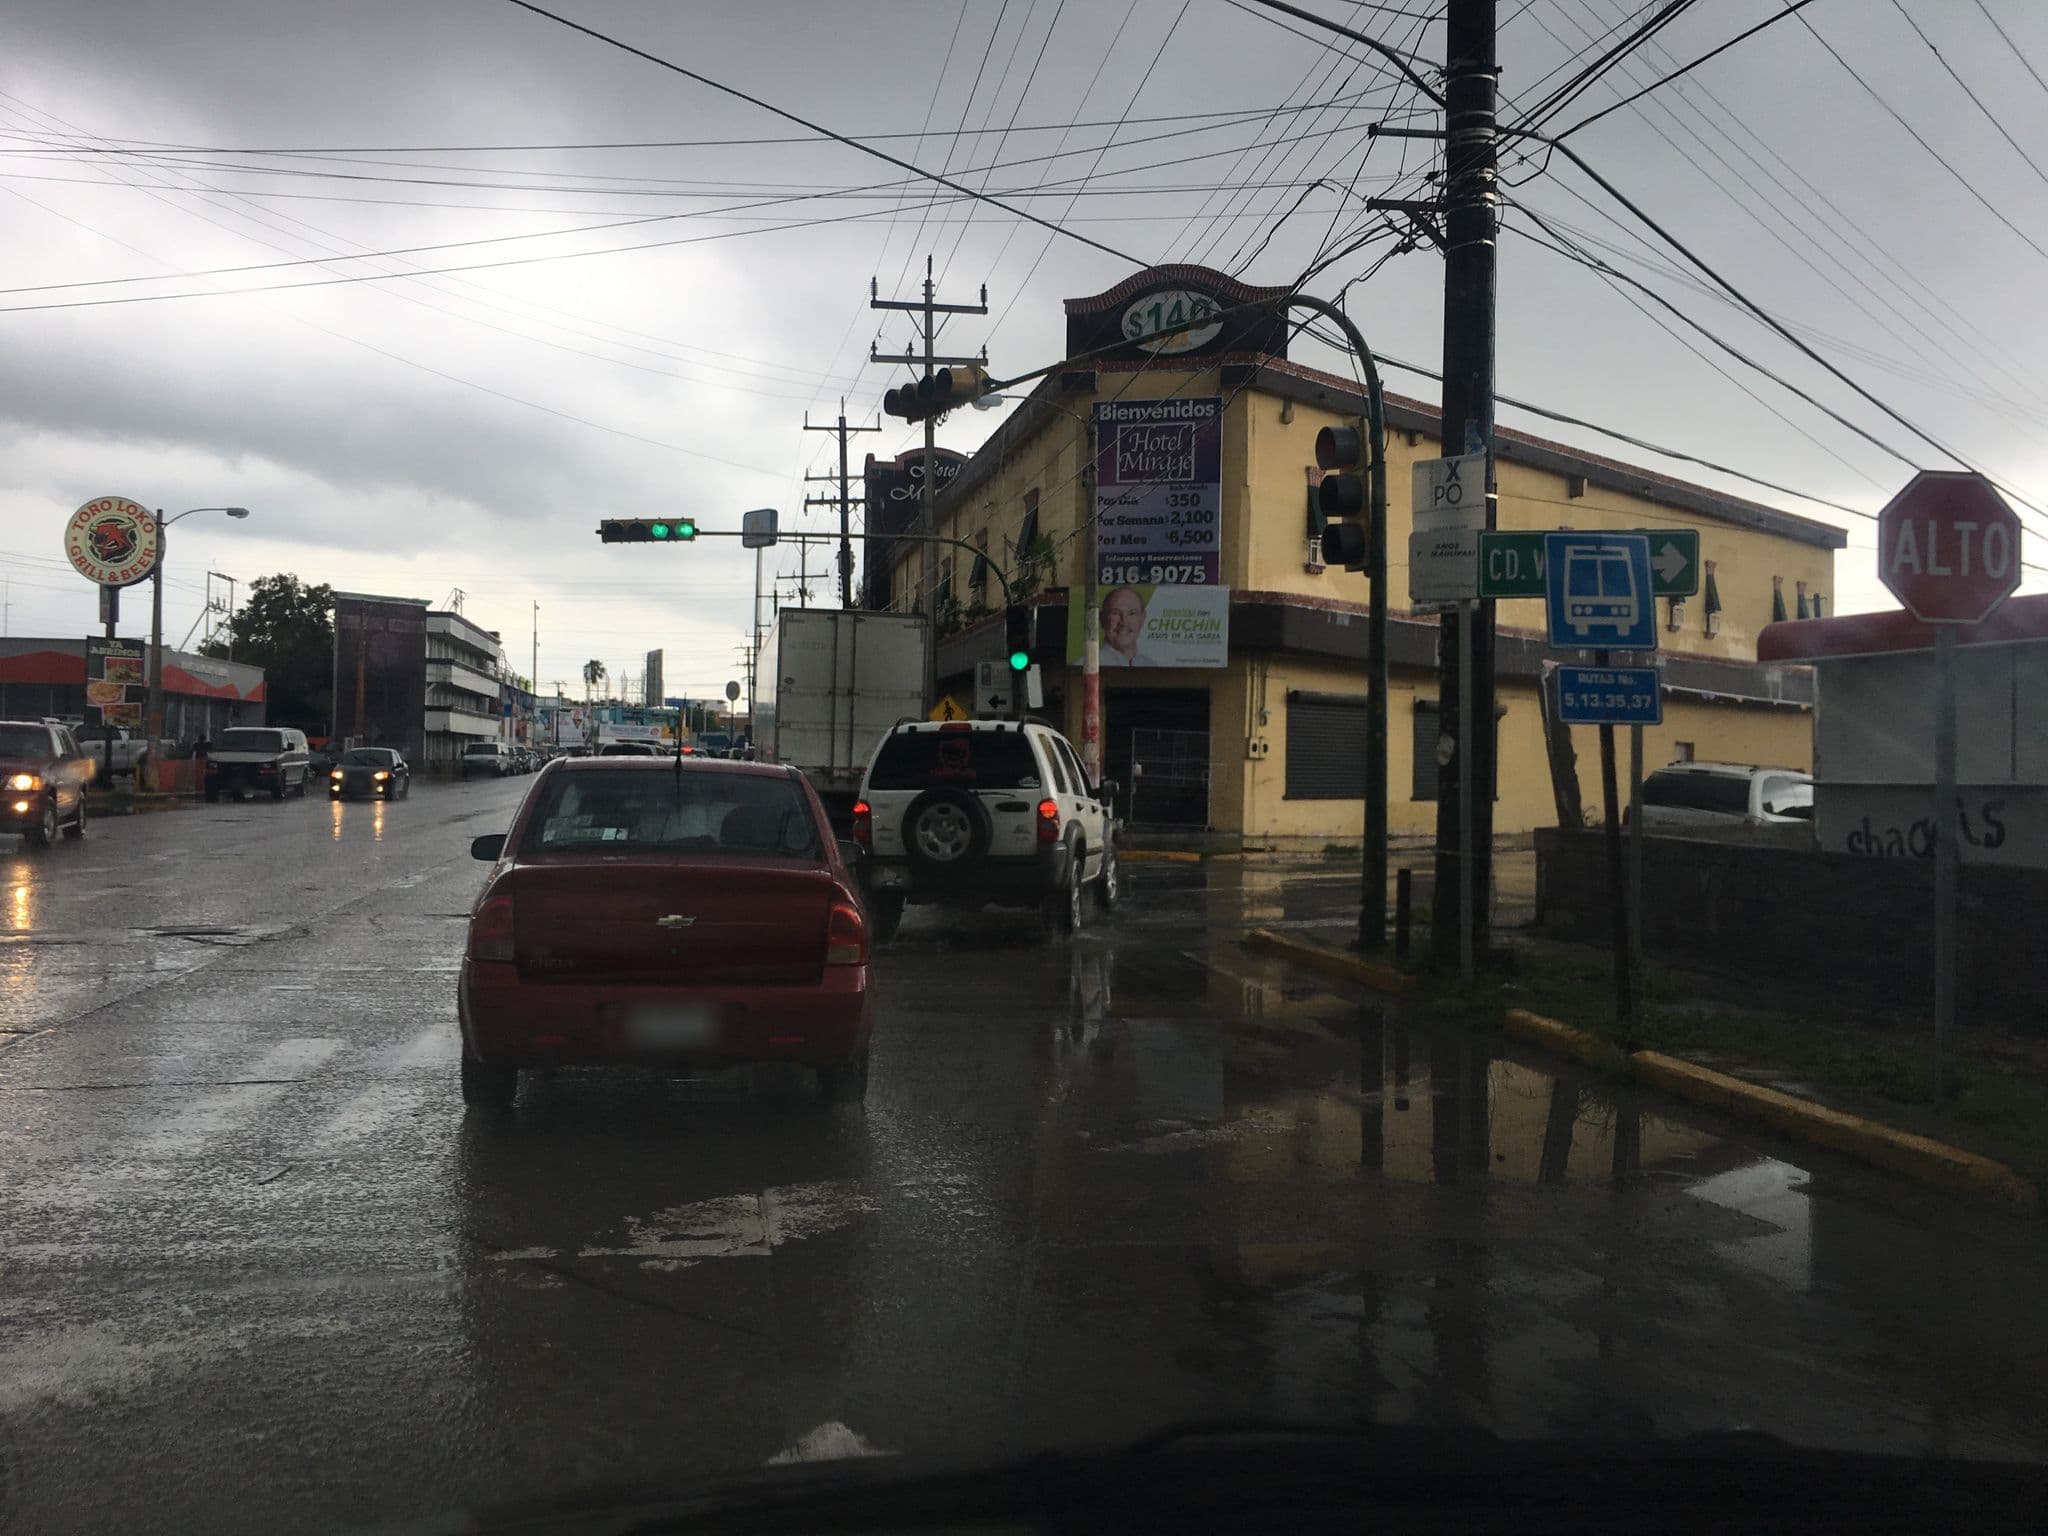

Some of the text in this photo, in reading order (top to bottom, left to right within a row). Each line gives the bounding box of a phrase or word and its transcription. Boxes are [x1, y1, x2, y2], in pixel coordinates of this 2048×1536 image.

[1099, 400, 1216, 421] Bienvenidos
[1128, 424, 1190, 452] Hotel
[1446, 461, 1461, 482] X
[1434, 483, 1463, 506] PO
[72, 500, 154, 534] TORO LOKO
[1891, 518, 2011, 580] ALTO
[1100, 565, 1207, 584] 816-9075
[1488, 548, 1527, 581] CD.
[108, 640, 123, 649] YA
[1578, 673, 1616, 685] RUTAS
